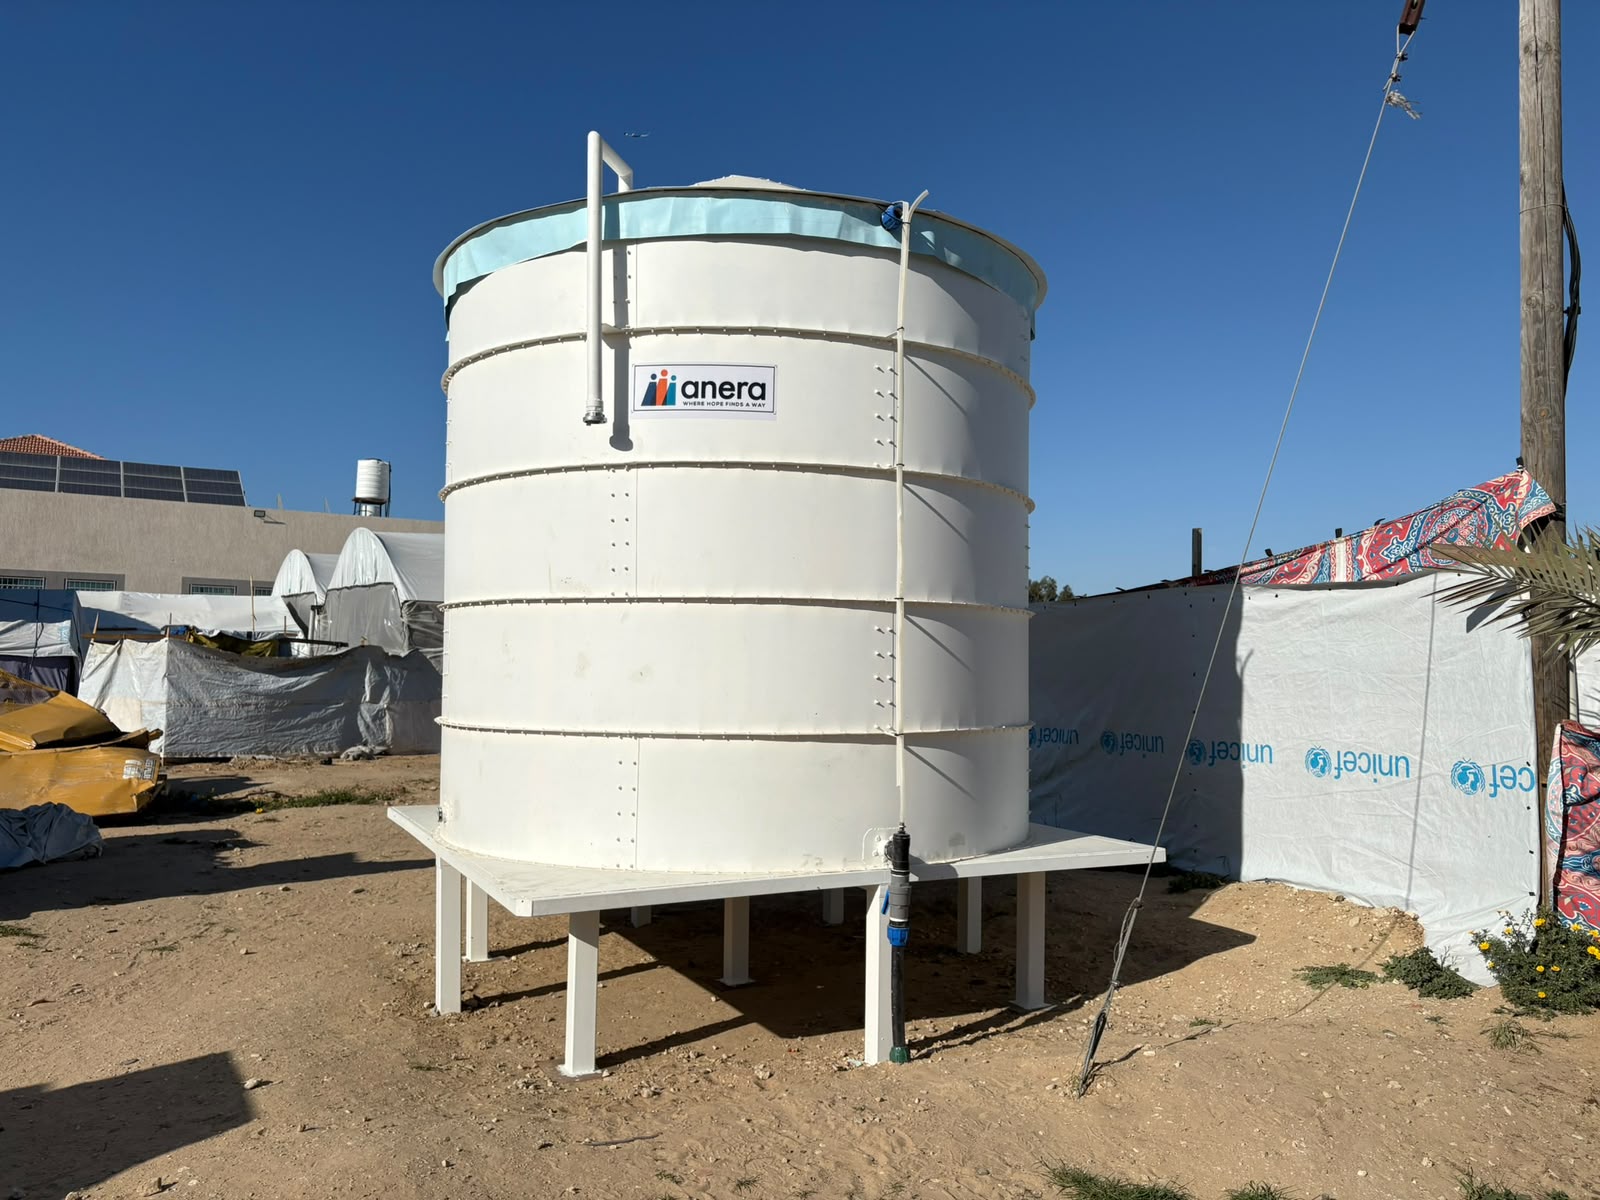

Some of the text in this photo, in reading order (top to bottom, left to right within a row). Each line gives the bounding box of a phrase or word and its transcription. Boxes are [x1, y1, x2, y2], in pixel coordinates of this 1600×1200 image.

[681, 380, 766, 400] anera
[1038, 727, 1080, 751] unicef
[1120, 732, 1165, 759] unicef
[1208, 740, 1273, 769] unicef
[1333, 749, 1411, 784] unicef
